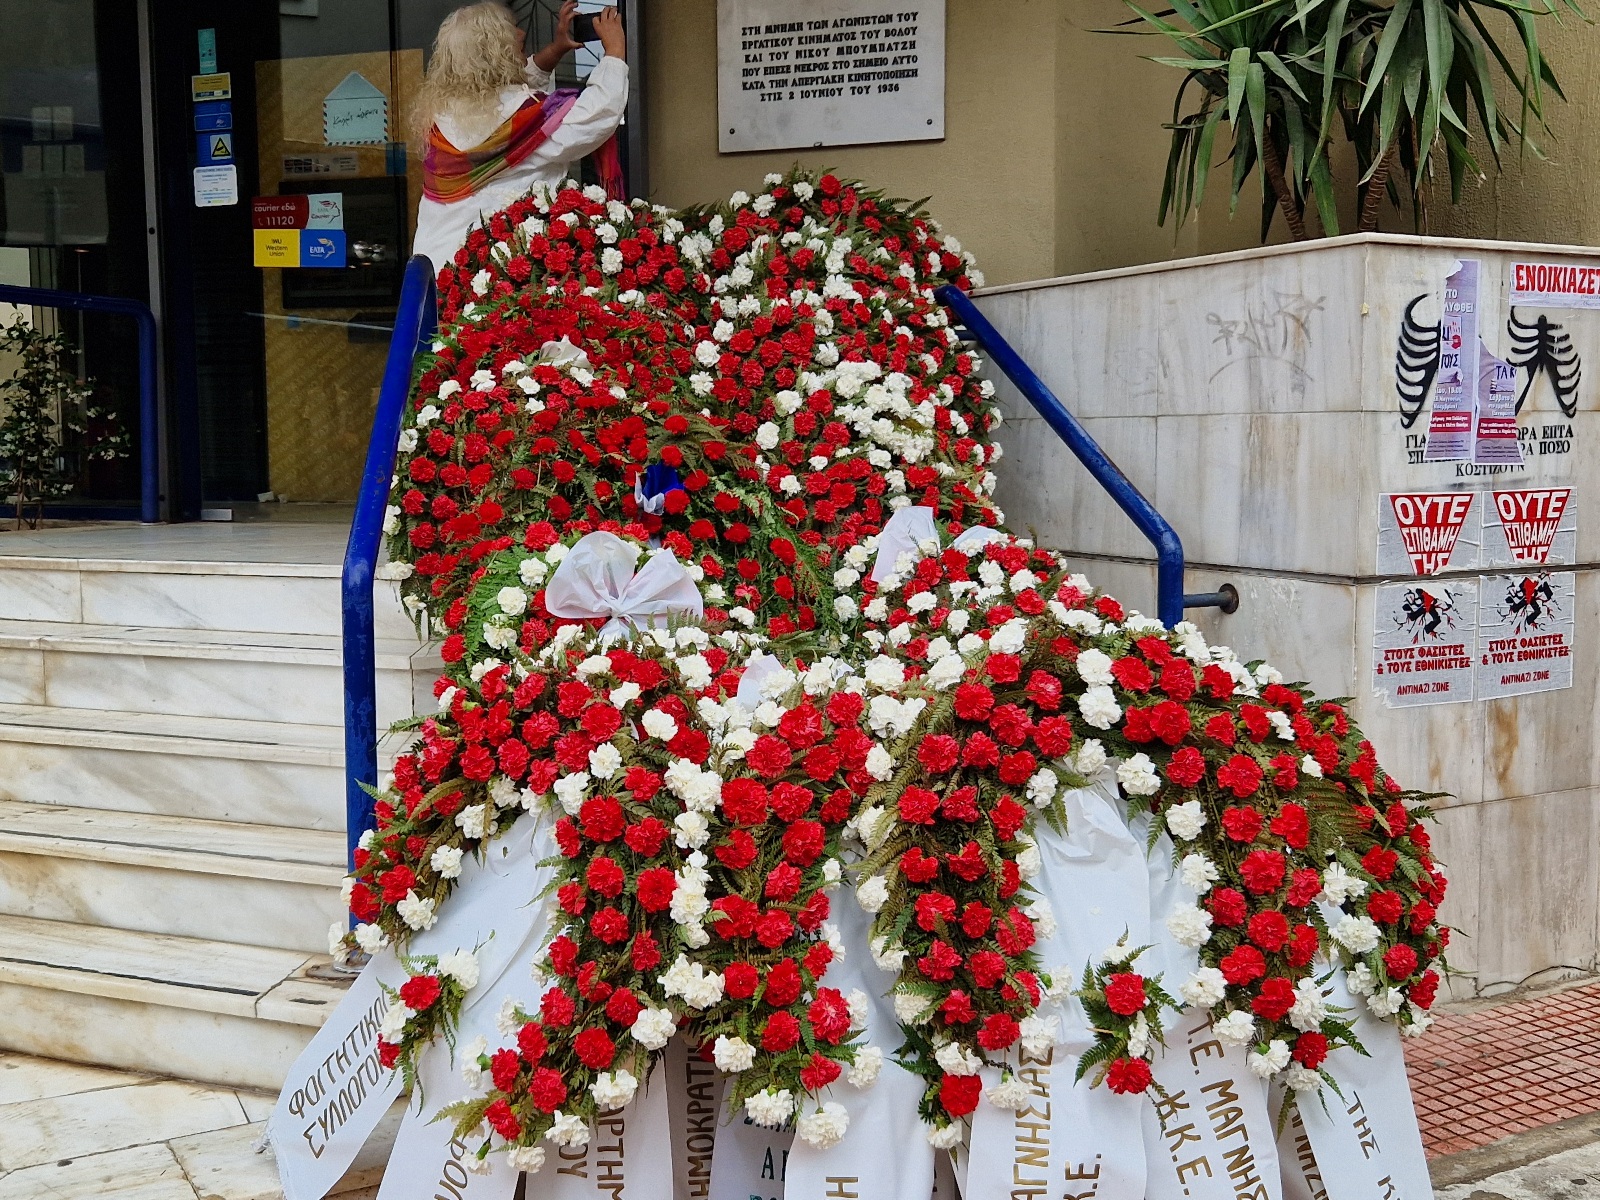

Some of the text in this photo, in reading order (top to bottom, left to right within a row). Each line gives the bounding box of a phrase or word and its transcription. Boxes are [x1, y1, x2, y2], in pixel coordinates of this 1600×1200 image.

[742, 12, 919, 36] ΣΤΗ ΜΝΗΜΗ ΤΩΝ ΑΓΩΝΙΣΤΩΝ ΤΟΥ
[742, 26, 918, 50] ΕΡΓΑΤΙΚΟΥ ΚΙΝΗΜΑΤΟΣ ΤΟΥ ΒΟΛΟΥ
[745, 40, 916, 63] ΚΑΙ ΤΟΥ ΝΙΚΟΥ ΜΠΟΥΜΠΑΤΖΗ
[742, 55, 918, 77] ΠΟΥ ΕΠΕΣΕ ΝΕΚΡΟΣ ΣΤΟ ΣΗΜΕΙΟ ΑΥΤΟ
[742, 68, 918, 91] ΚΑΤΑ ΤΗΝ ΑΠΕΡΓΙΑΚΗ ΚΙΝΗΤΟΠΟΙΗΣΗ
[760, 83, 900, 102] ΣΤΙΣ 2 ΙΟΥΝΙΟΥ ΤΟΥ 1936
[266, 216, 295, 226] 11120
[1542, 424, 1574, 439] ΕΠΤΑ
[1539, 440, 1571, 455] ΠΟΣΟ
[1394, 495, 1470, 526] ΟΥΤΕ
[1497, 490, 1568, 521] ΟΥΤΕ
[1402, 526, 1460, 553] ΣΠΙΘΑΜΗ
[1504, 521, 1558, 547] ΣΠΙΘΑΜΗ
[1384, 644, 1465, 661] ΣΤΟΥΣ ΦΑΣΙΣΤΕΣ
[1489, 634, 1564, 652] ΣΤΟΥΣ ΦΑΣΙΣΤΕΣ
[1387, 661, 1412, 673] ΤΟΥΣ
[1414, 656, 1471, 671] ΕΘΝΙΚΙΣΤΕΣ
[1492, 651, 1515, 664] ΤΟΥΣ
[1517, 646, 1569, 661] ΕΘΝΙΚΙΣΤΕΣ
